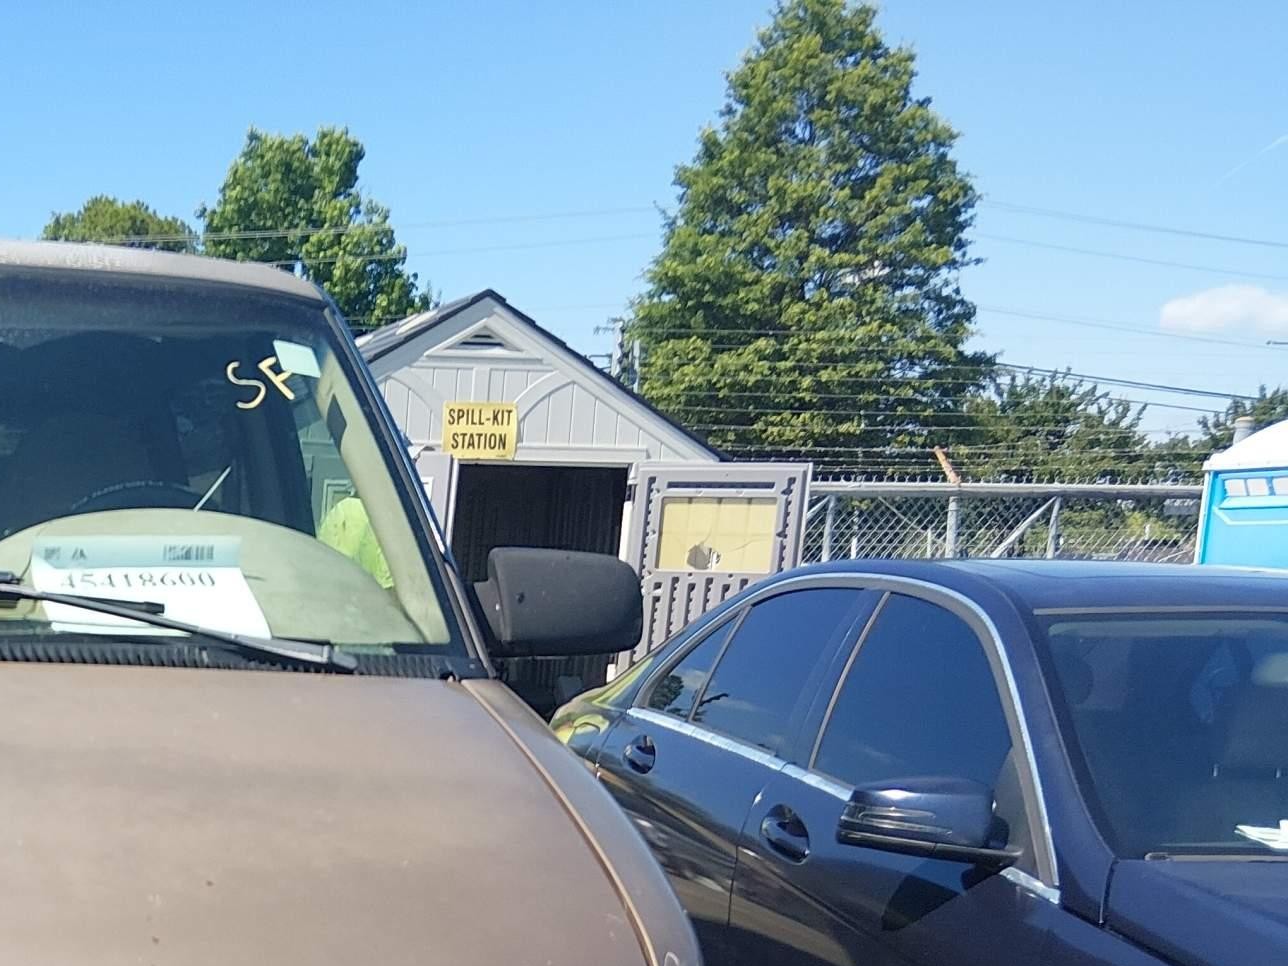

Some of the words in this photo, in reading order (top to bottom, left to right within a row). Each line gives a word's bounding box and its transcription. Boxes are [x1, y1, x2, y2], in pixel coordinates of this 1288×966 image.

[447, 408, 513, 426] SPILL-KIT
[451, 432, 507, 450] STATION
[61, 571, 216, 588] 45418600
